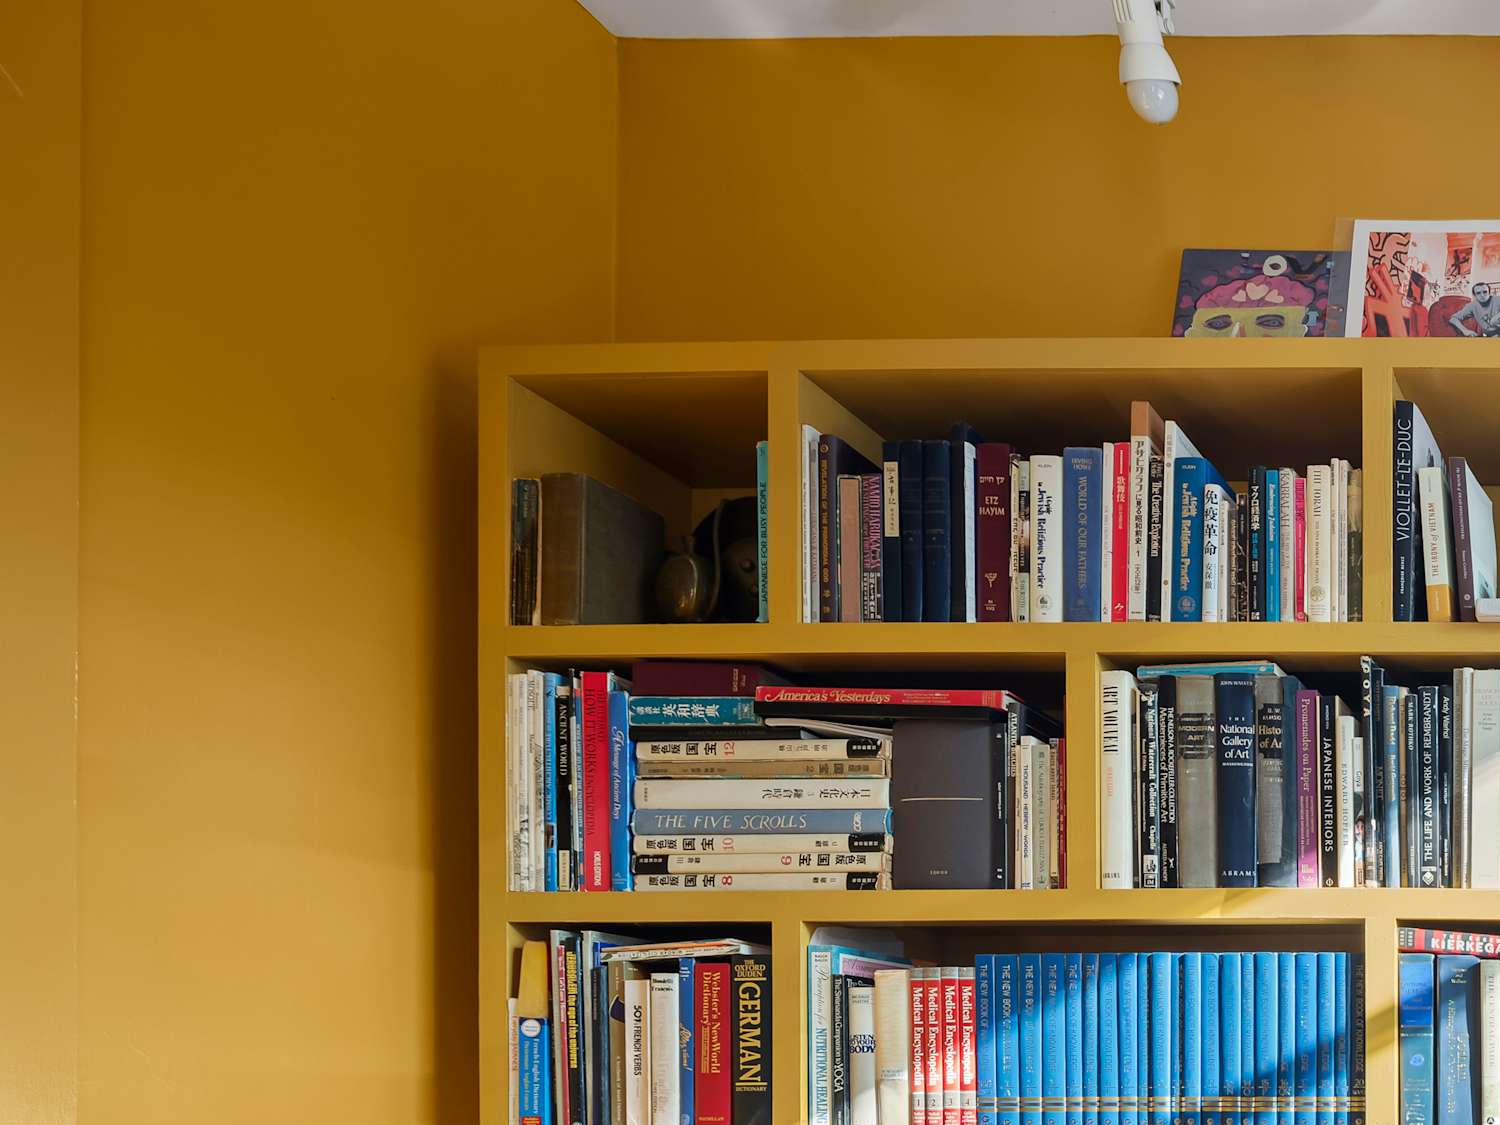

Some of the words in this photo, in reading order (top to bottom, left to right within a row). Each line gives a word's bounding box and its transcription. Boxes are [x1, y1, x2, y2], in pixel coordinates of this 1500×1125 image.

[1078, 476, 1088, 511] WORLD
[1152, 481, 1162, 494] The
[1396, 418, 1411, 542] VIOLLET-LE-DUC
[1078, 514, 1087, 526] OF
[1151, 494, 1161, 523] Creative
[1078, 528, 1088, 548] OUR
[1149, 524, 1161, 557] Explosion
[1078, 551, 1088, 588] FATHERS
[764, 690, 829, 702] America's
[830, 690, 892, 703] Yesterdays
[1440, 695, 1450, 714] Andy
[1299, 698, 1311, 751] Promenades
[1407, 701, 1415, 721] MARK
[1421, 691, 1432, 749] REMBRANDT
[1159, 707, 1168, 759] Masterpieces
[1220, 724, 1256, 735] National
[1407, 723, 1415, 751] ROTHKO
[1442, 714, 1450, 739] Warhol
[723, 741, 735, 757] 12
[1222, 736, 1253, 749] Gallery
[1224, 749, 1234, 759] of
[1234, 749, 1249, 759] Art
[1159, 761, 1168, 771] of
[1302, 753, 1310, 765] on
[1323, 737, 1333, 791] JAPANESE
[1422, 751, 1433, 765] OF
[1159, 772, 1168, 807] Primitive
[1299, 767, 1311, 792] Paper
[1354, 770, 1363, 788] Goya
[1423, 770, 1433, 794] WORK
[1159, 809, 1168, 823] Art
[1423, 797, 1433, 818] AND
[655, 815, 686, 829] THE
[693, 815, 731, 829] FIVE
[740, 815, 808, 830] SCROLLS
[1324, 795, 1333, 853] INTERIORS
[1424, 820, 1433, 840] LIFE
[722, 837, 735, 850] 10
[1424, 842, 1433, 862] THE
[721, 874, 734, 886] 8
[700, 972, 712, 1026] Dictionary
[710, 972, 721, 1020] Webster's
[913, 987, 924, 1025] Medical
[928, 987, 939, 1024] Medical
[945, 986, 956, 1023] Medical
[962, 986, 972, 1023] Medical
[633, 1004, 643, 1023] 501
[633, 1025, 643, 1053] FRENCH
[739, 982, 762, 1082] GERMAN
[633, 1053, 643, 1076] VERBS
[815, 1027, 828, 1085] NUTRITIONAL
[912, 1026, 924, 1086] Encyclopedia
[928, 1026, 940, 1085] Encyclopedia
[945, 1024, 957, 1084] Encyclopedia
[961, 1025, 973, 1085] Encyclopedia
[834, 1063, 844, 1092] YOGA
[815, 1086, 828, 1124] HEALING
